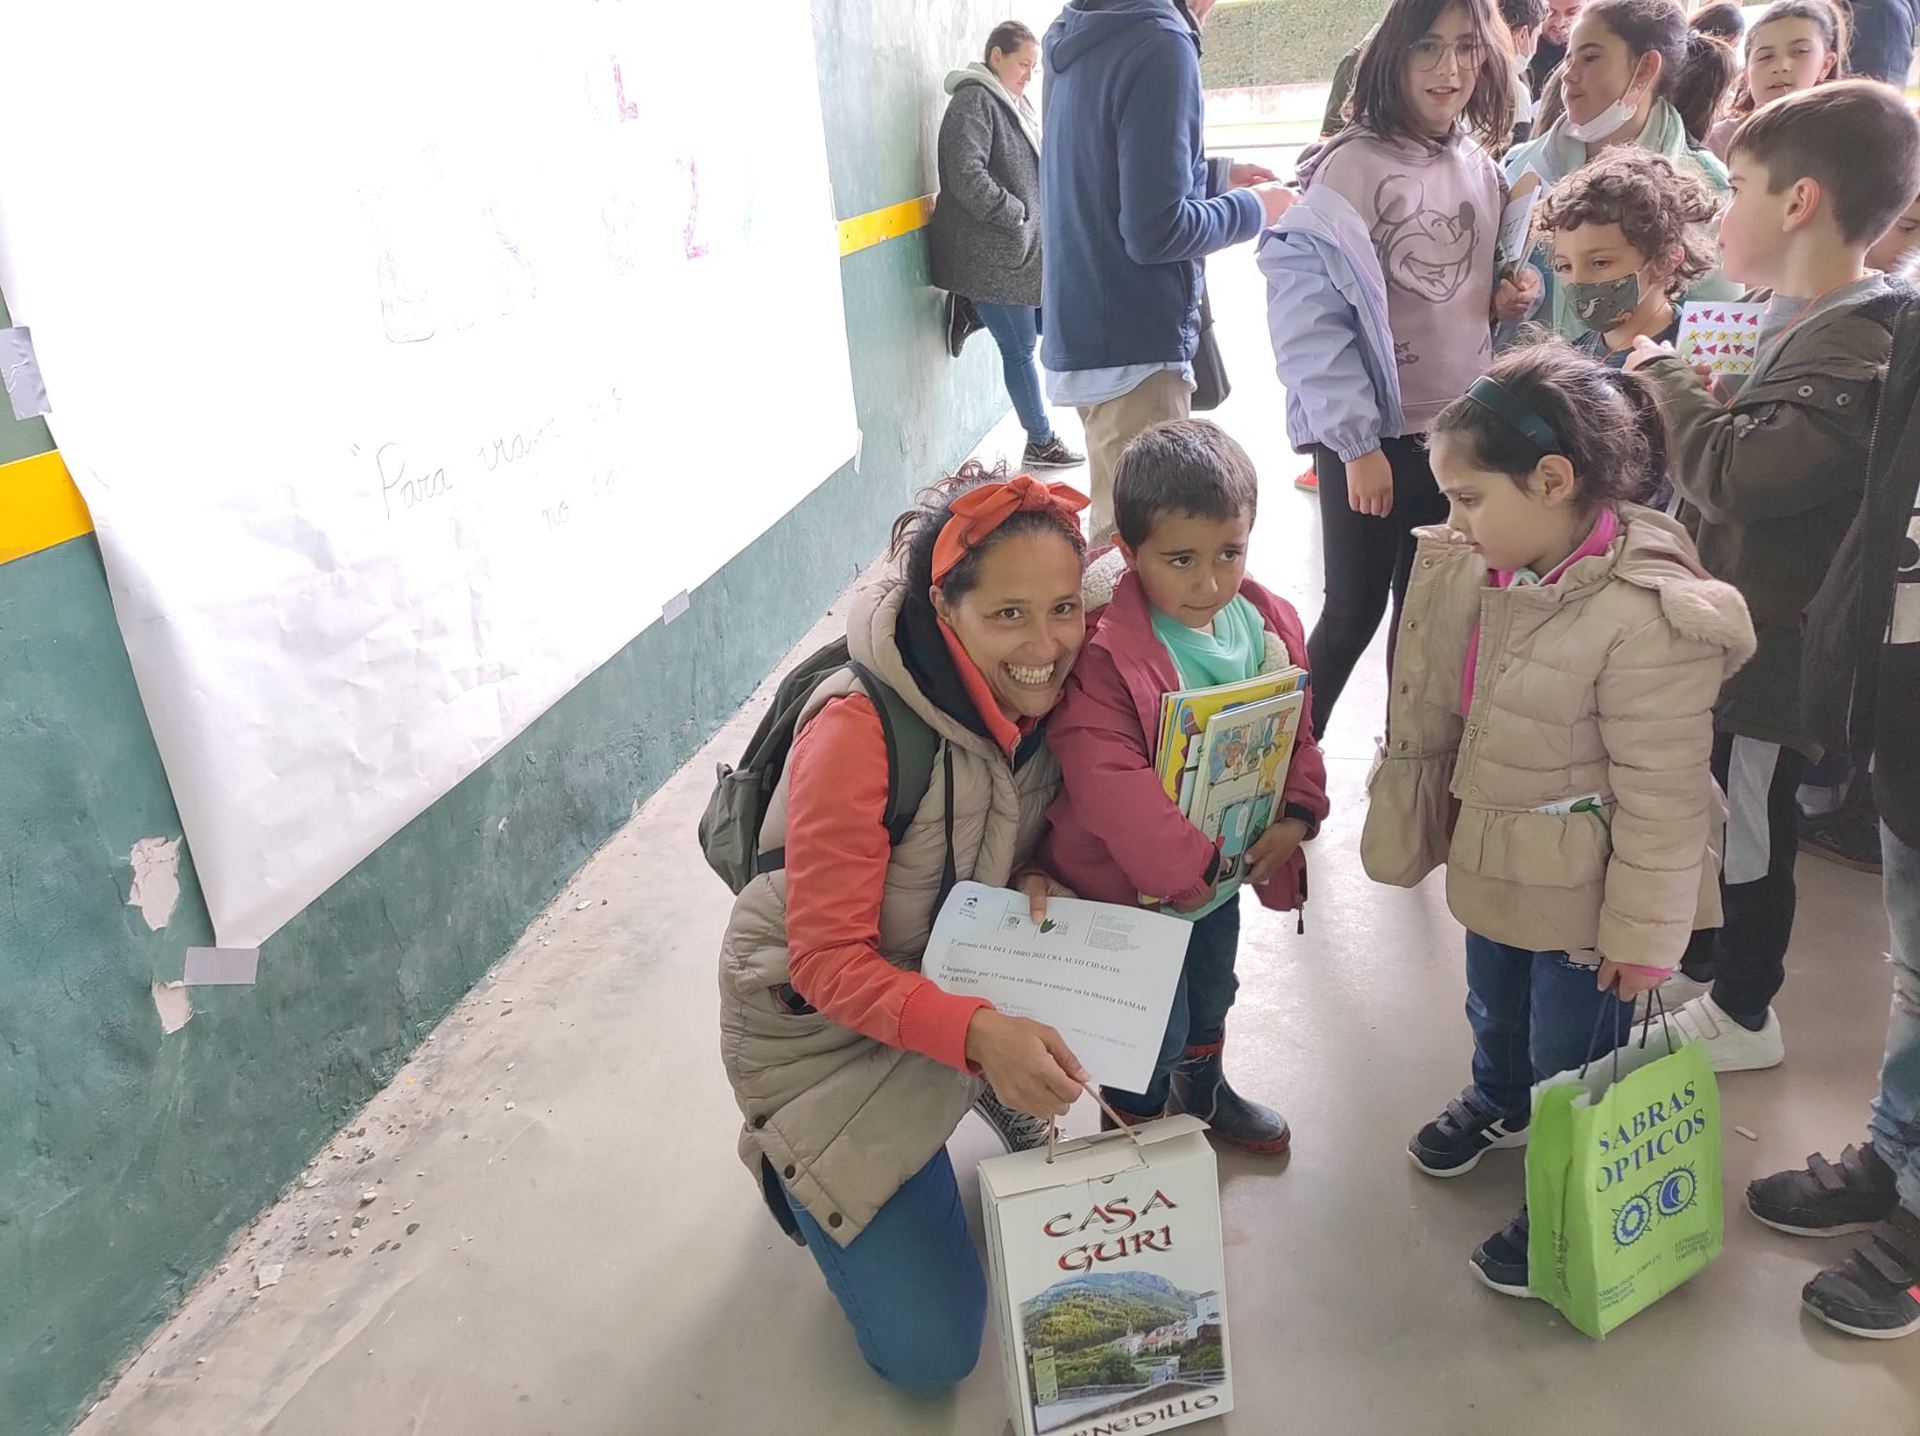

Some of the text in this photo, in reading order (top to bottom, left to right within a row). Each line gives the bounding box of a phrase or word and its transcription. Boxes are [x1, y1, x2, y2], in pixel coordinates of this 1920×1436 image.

[1008, 947, 1031, 957] LIBRO
[1031, 951, 1046, 960] 2022
[1063, 956, 1085, 967] ALTO
[1598, 1080, 1696, 1157] SABRAS
[1043, 1189, 1179, 1238] CASA
[1058, 1225, 1174, 1273] GURI
